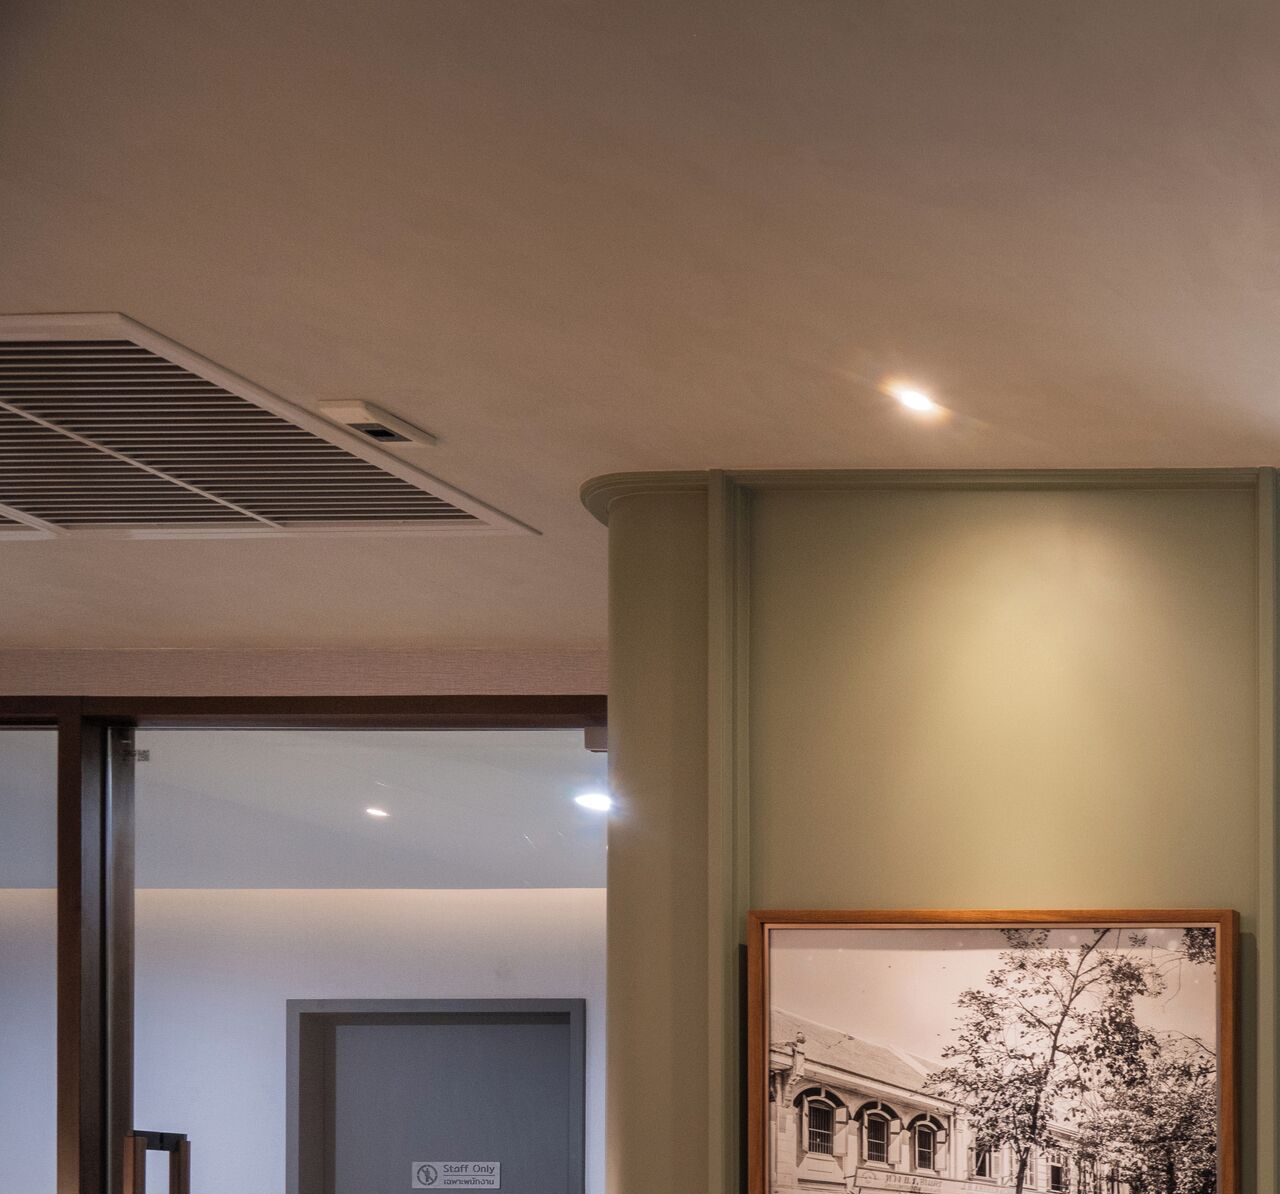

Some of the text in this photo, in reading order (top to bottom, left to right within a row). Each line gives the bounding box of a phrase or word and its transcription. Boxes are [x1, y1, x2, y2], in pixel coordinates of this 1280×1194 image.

[443, 1164, 495, 1174] Staff Only
[443, 1177, 495, 1185] เฉพาะพนักงาน
